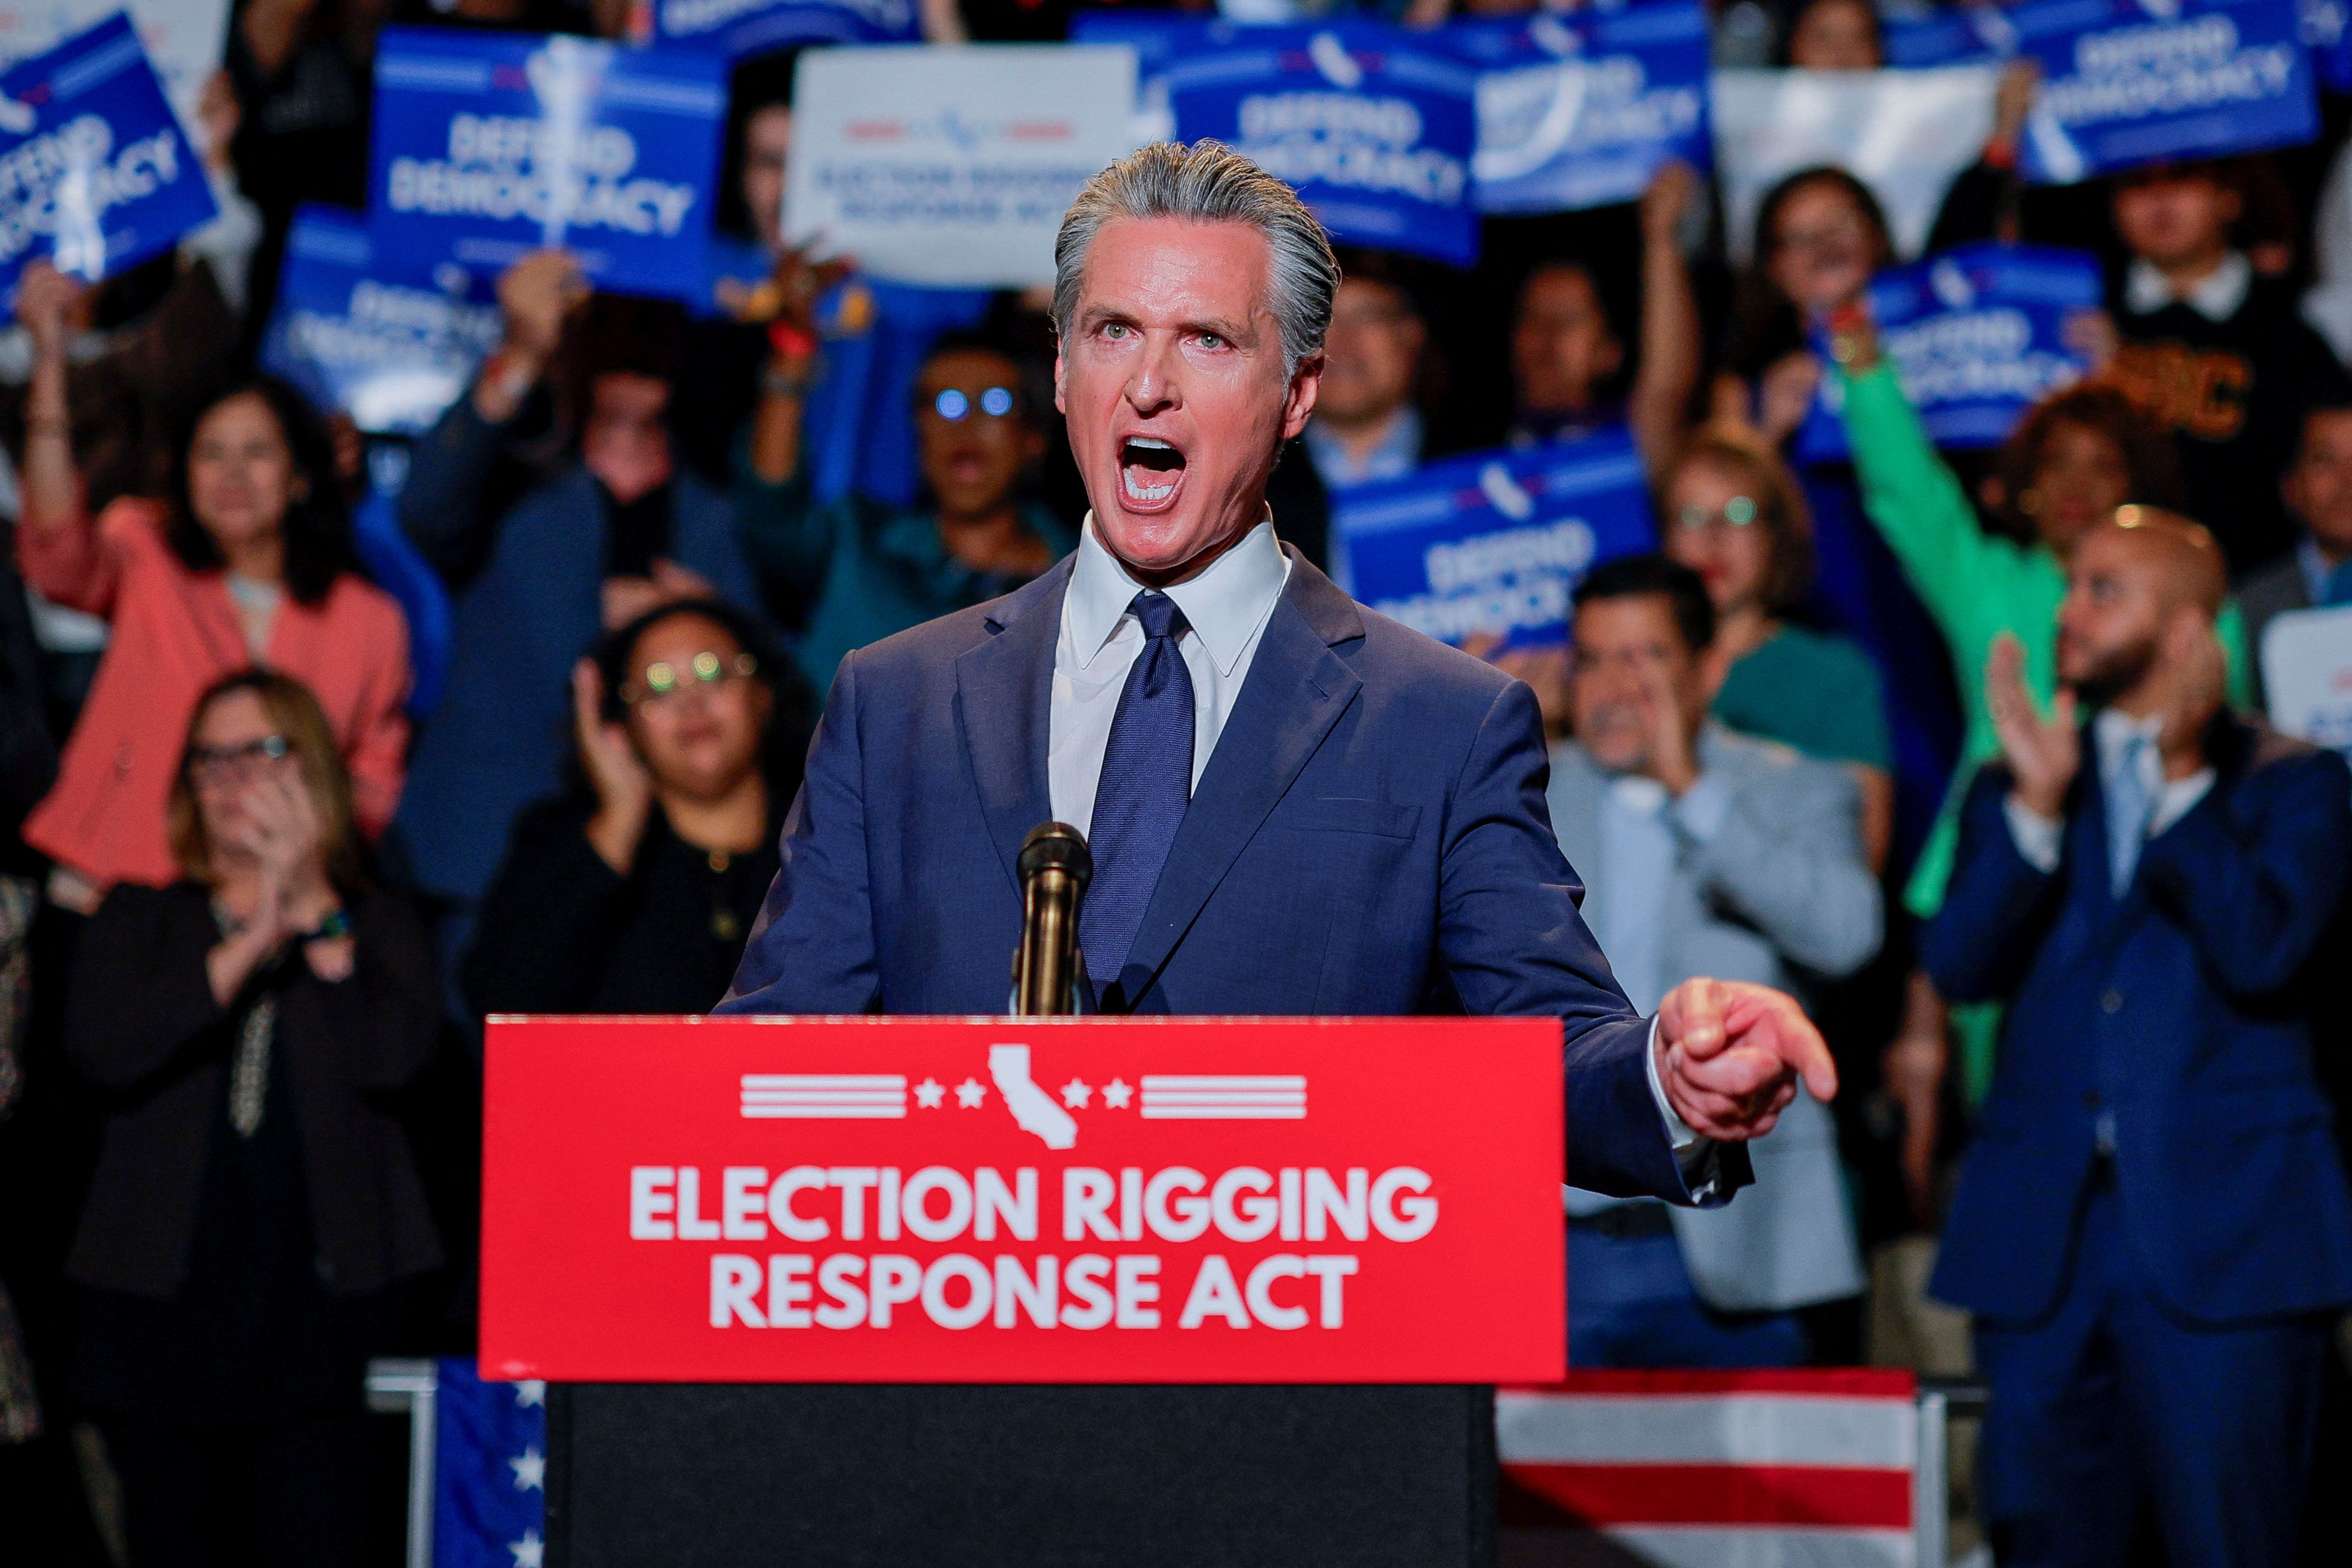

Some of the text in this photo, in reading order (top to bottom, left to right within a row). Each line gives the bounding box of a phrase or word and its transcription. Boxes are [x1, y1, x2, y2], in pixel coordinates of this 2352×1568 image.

[630, 1166, 1438, 1242] ELECTION RIGGING
[710, 1254, 1358, 1330] RESPONSE ACT
